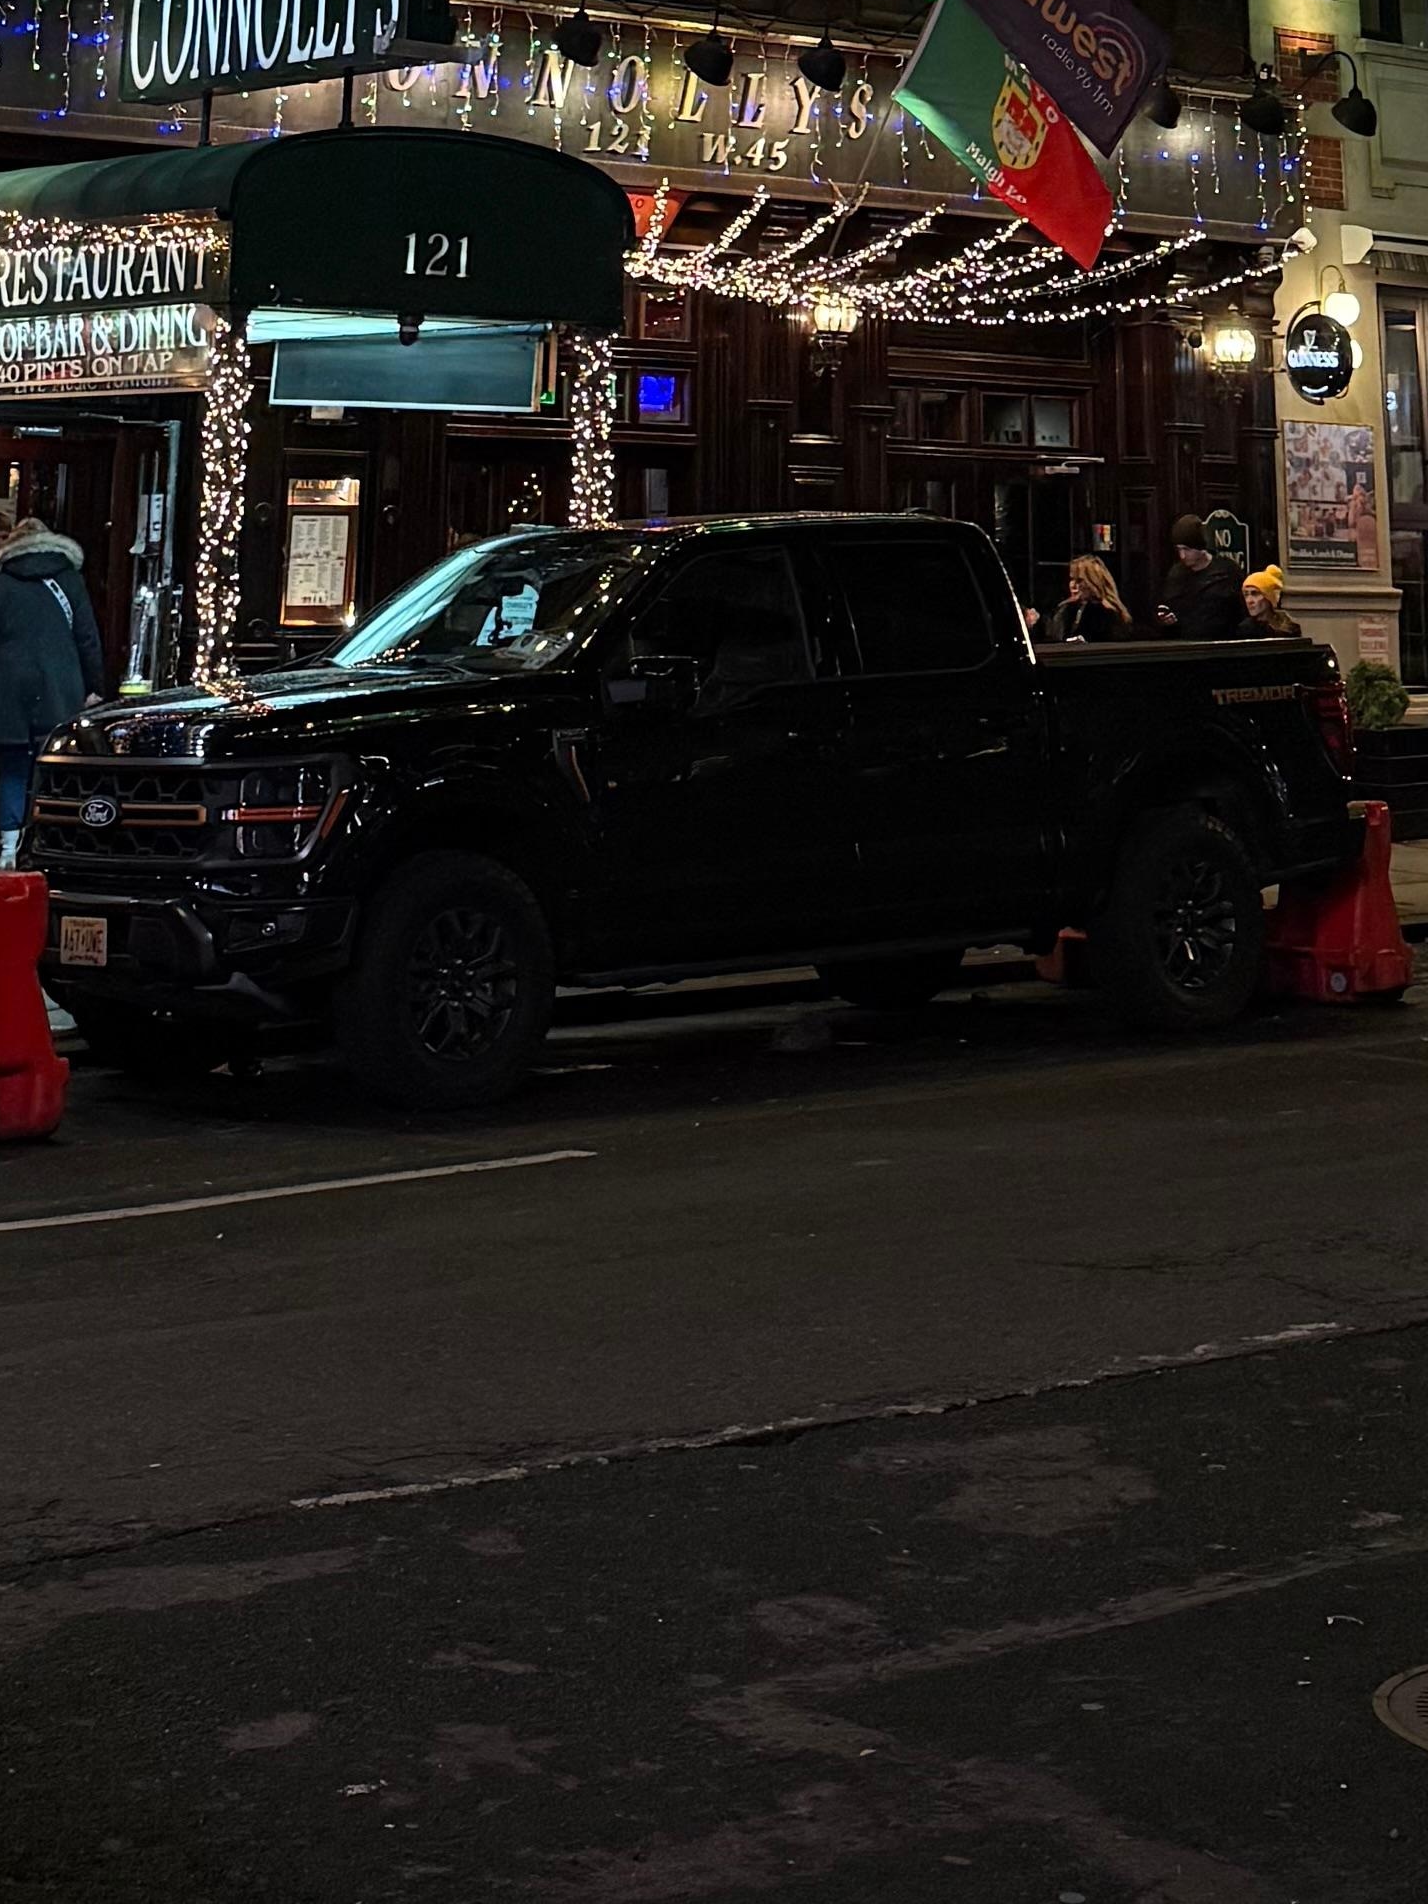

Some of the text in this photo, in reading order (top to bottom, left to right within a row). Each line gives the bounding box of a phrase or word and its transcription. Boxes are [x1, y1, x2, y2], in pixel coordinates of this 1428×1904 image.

[1041, 32, 1074, 70] radio
[966, 142, 1007, 186] Maigh
[404, 232, 471, 279] 121
[34, 314, 86, 358] BAR
[91, 314, 114, 355] &
[118, 303, 208, 354] DINING
[23, 358, 84, 382] PINTS
[92, 356, 125, 376] ON
[129, 353, 173, 373] TAP
[1215, 529, 1231, 548] NO
[1212, 685, 1294, 705] TREMOR
